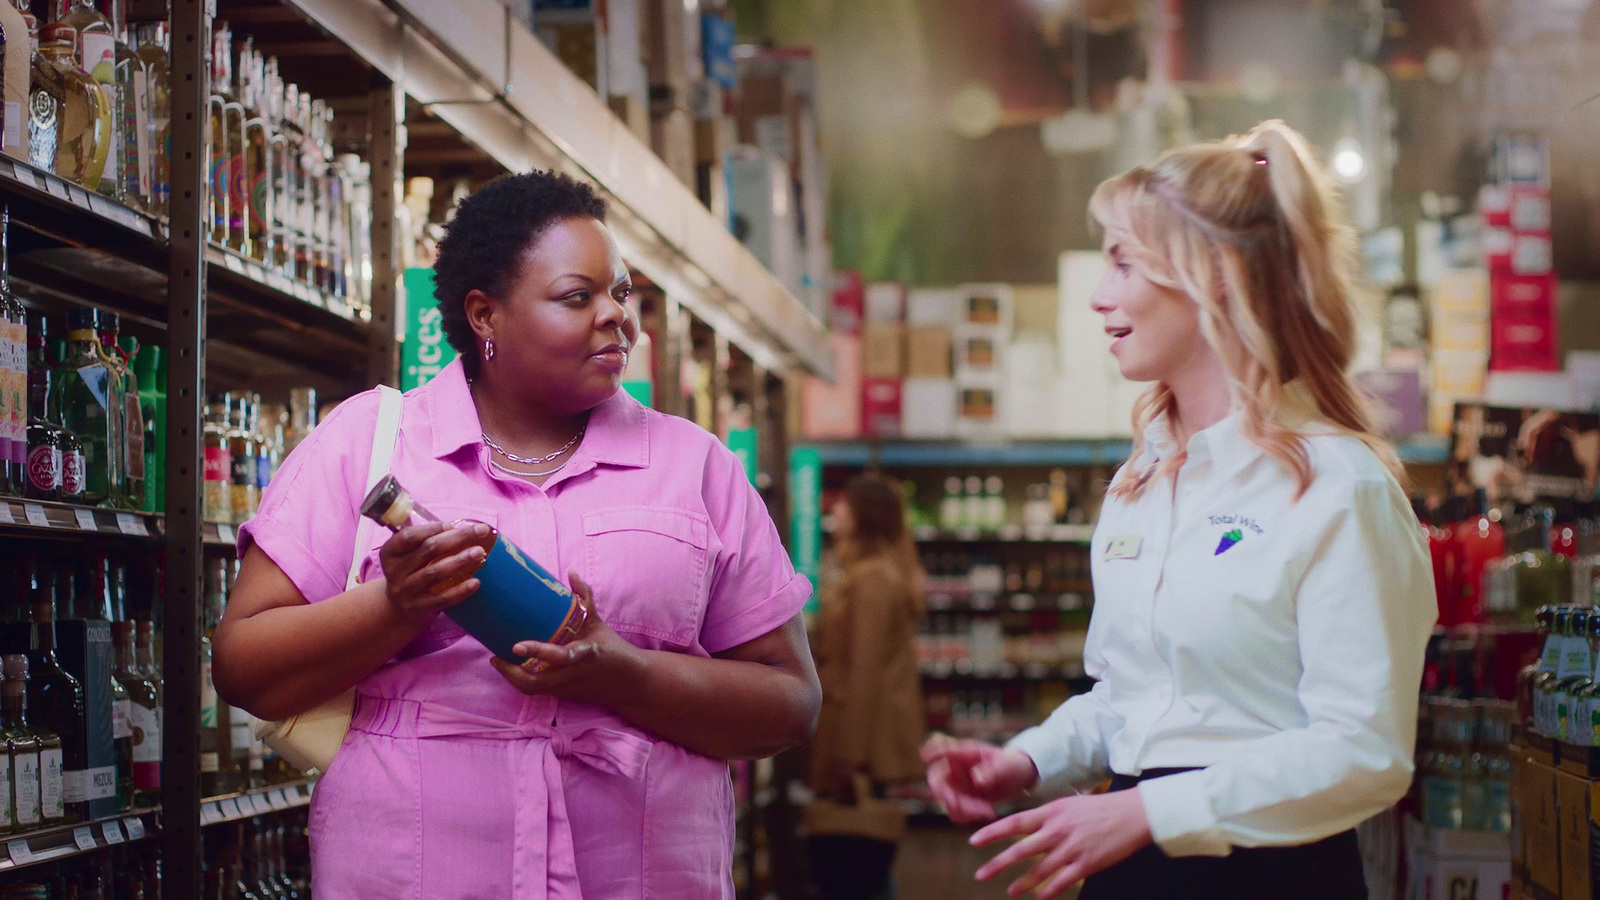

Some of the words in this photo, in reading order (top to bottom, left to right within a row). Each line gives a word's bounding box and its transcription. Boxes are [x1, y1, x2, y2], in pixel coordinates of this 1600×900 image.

[1208, 513, 1238, 526] Total
[1239, 515, 1265, 536] Wine
[93, 771, 113, 788] MEZCAL
